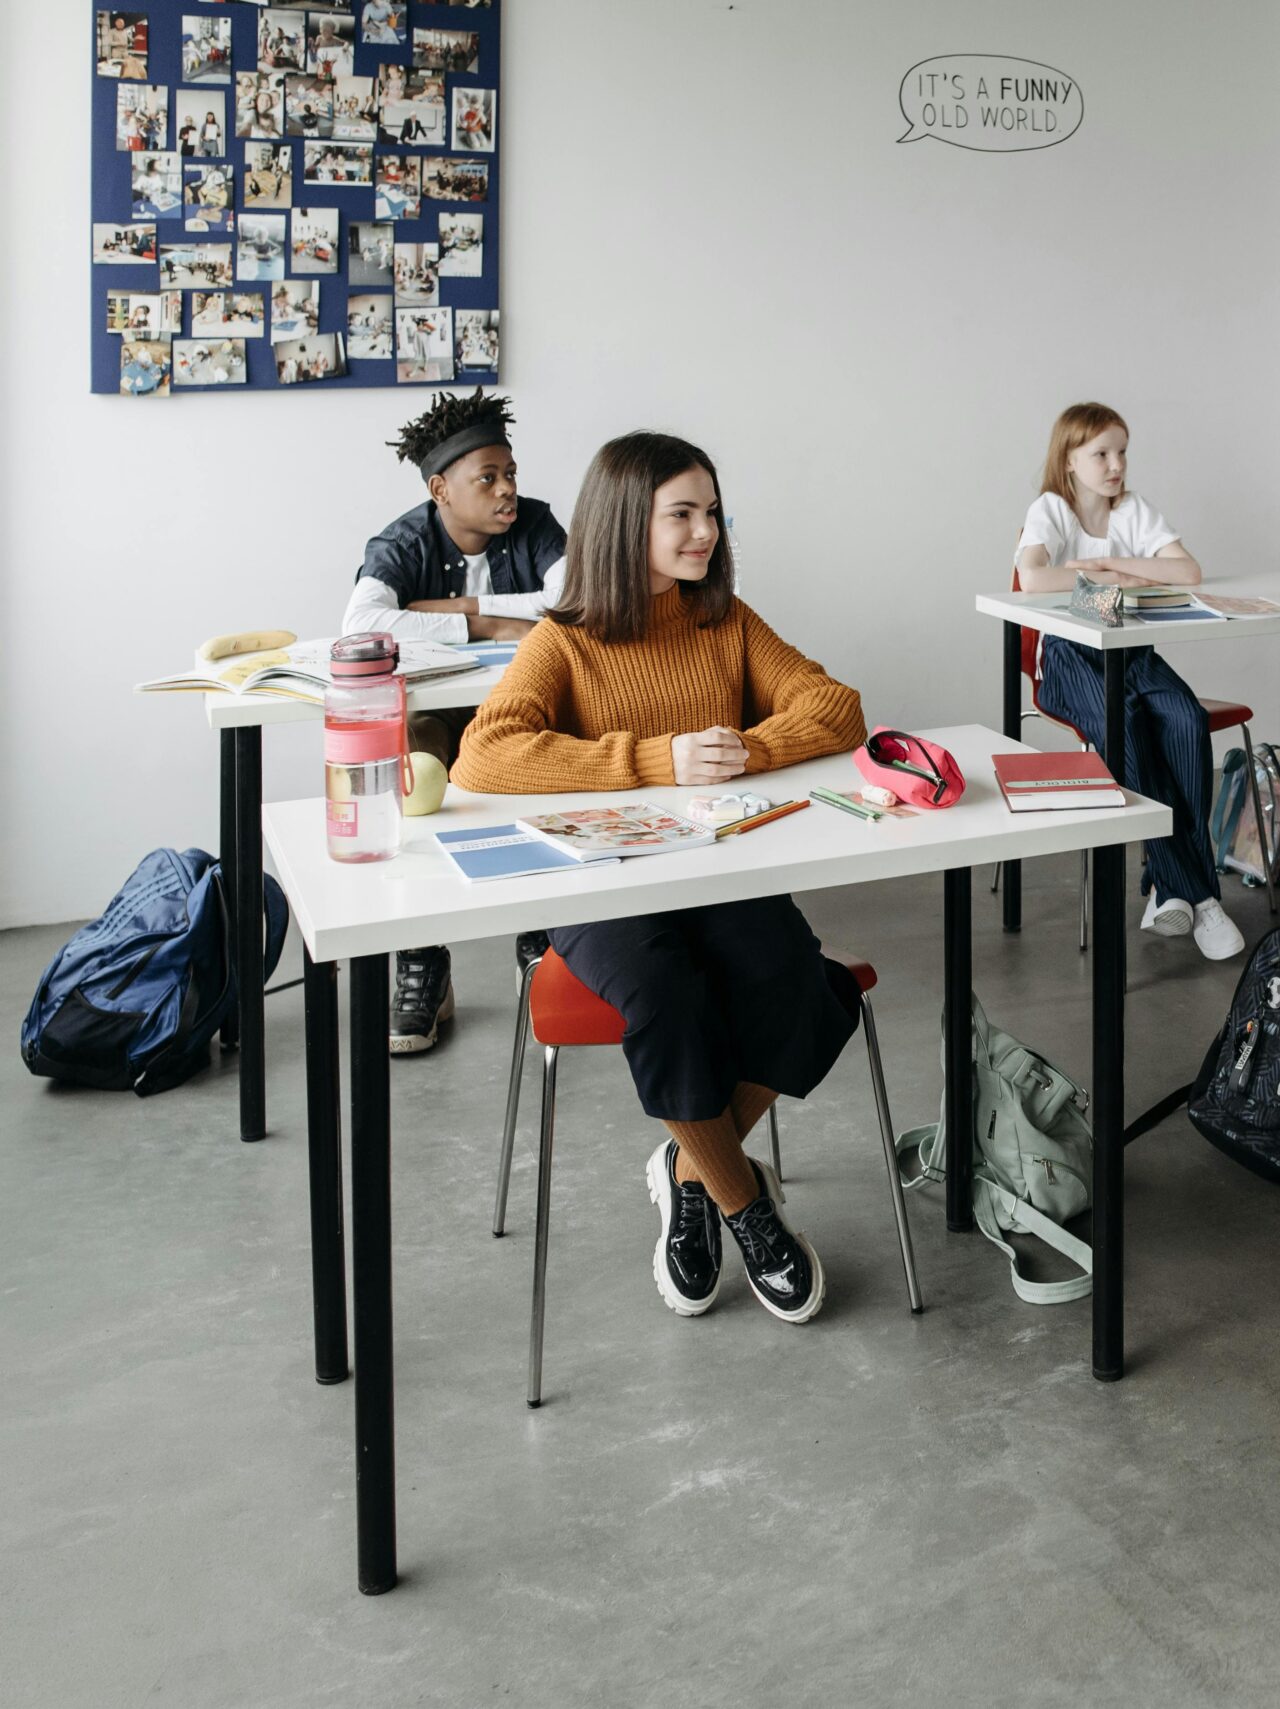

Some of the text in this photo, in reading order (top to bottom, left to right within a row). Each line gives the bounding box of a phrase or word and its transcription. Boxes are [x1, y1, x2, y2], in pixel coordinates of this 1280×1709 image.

[919, 74, 1073, 104] IT'S A FUNNY
[922, 103, 969, 128] OLD
